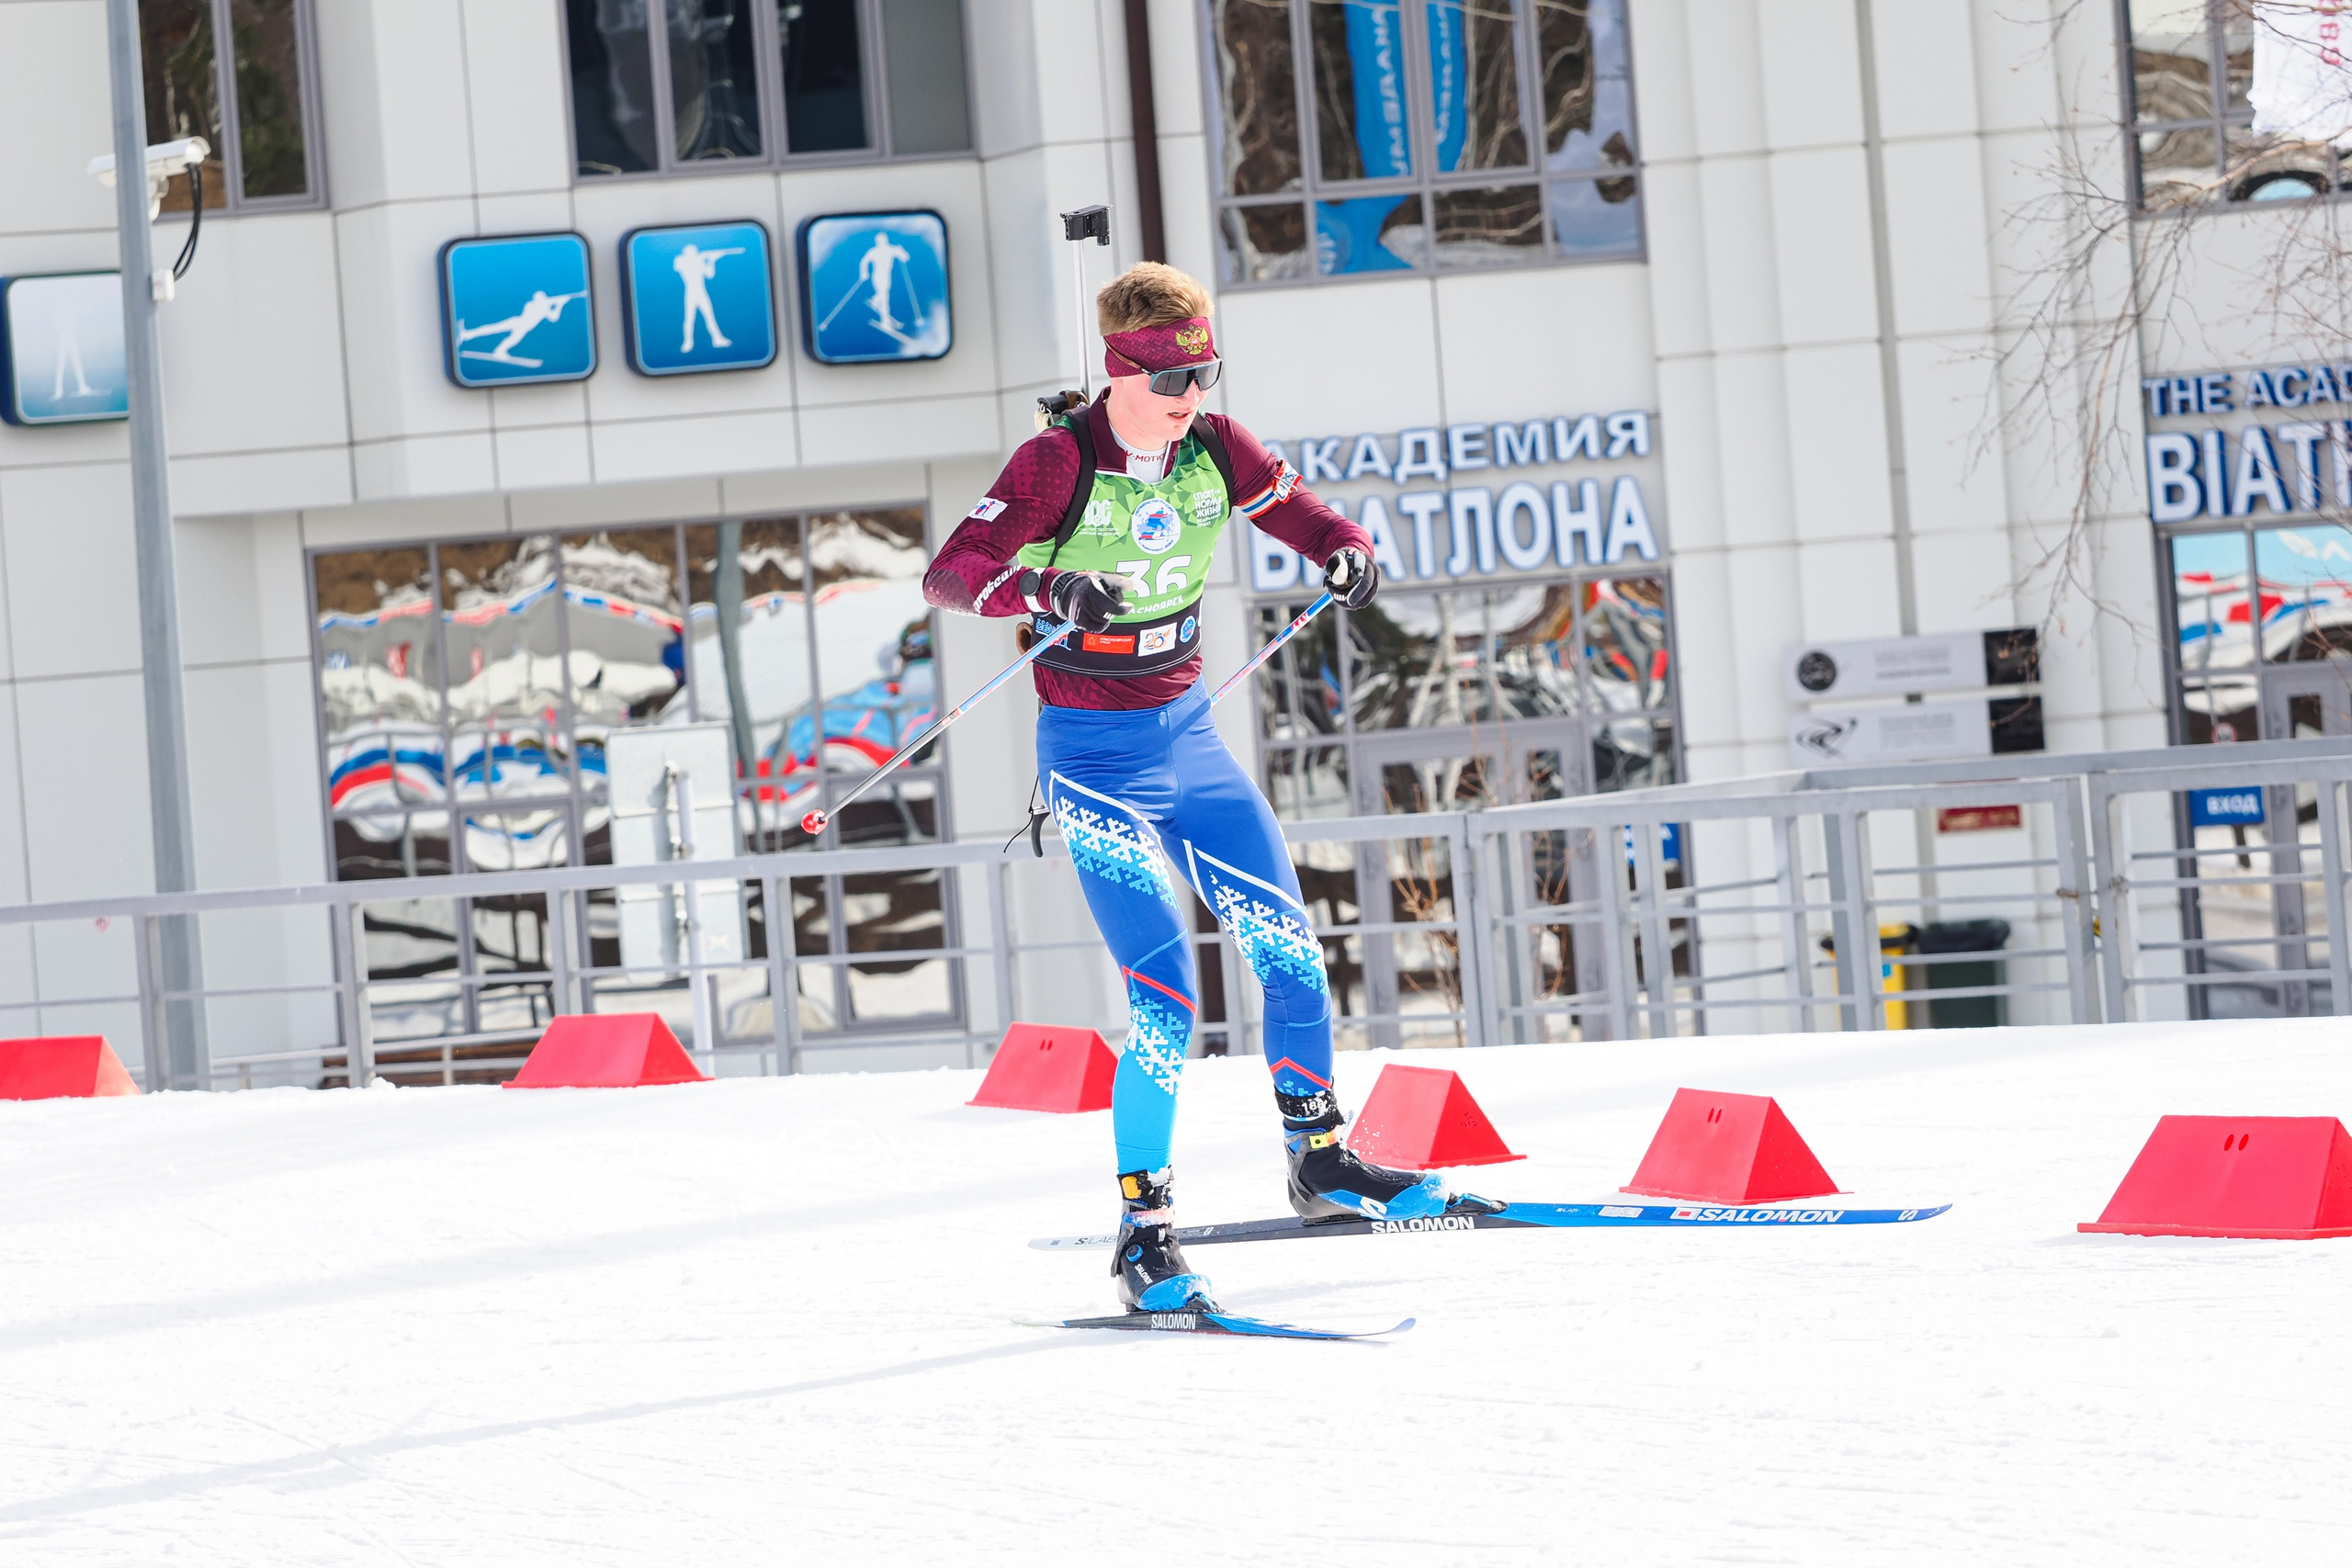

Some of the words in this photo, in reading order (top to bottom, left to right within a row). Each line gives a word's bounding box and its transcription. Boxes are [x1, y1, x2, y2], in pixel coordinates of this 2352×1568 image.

[2142, 372, 2233, 419] THE
[1115, 554, 1193, 597] 36
[1129, 595, 1183, 614] АСНОЯРСК
[2206, 794, 2260, 816] ВХОД
[1372, 1216, 1474, 1234] SALOMON
[1698, 1208, 1844, 1223] SALOMON
[1151, 1314, 1196, 1329] SALOMON
